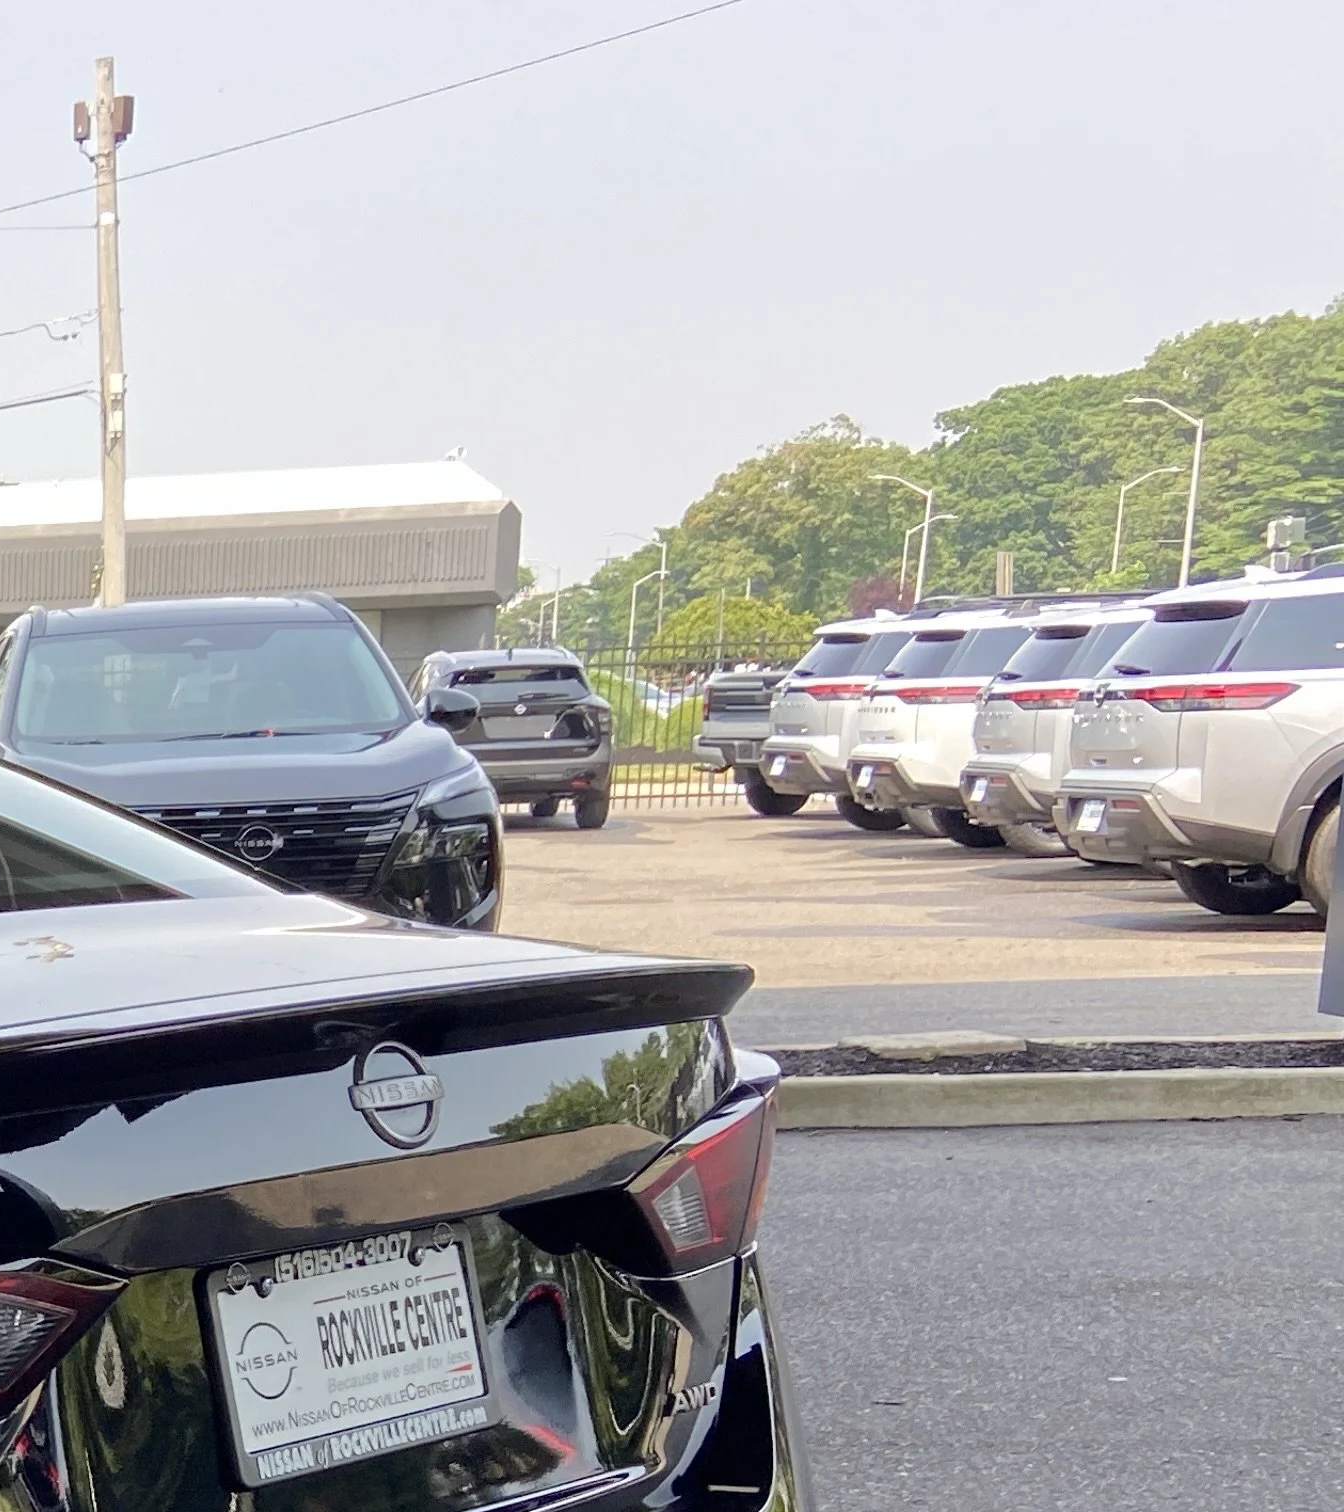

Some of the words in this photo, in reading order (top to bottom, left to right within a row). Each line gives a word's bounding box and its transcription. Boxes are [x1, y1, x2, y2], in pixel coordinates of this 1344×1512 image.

[359, 1078, 442, 1103] NISSAN
[346, 1279, 400, 1300] NISSAN
[405, 1275, 424, 1289] OF
[316, 1300, 406, 1369] ROCKVILLE
[404, 1288, 468, 1350] CENTRE
[235, 1348, 298, 1374] NISSAN
[328, 1372, 379, 1393] Because
[382, 1366, 402, 1380] we
[403, 1360, 425, 1377] sell
[427, 1356, 444, 1372] for
[447, 1350, 471, 1366] less
[671, 1382, 718, 1417] AWD
[257, 1445, 314, 1480] NISSAN
[317, 1440, 330, 1469] of
